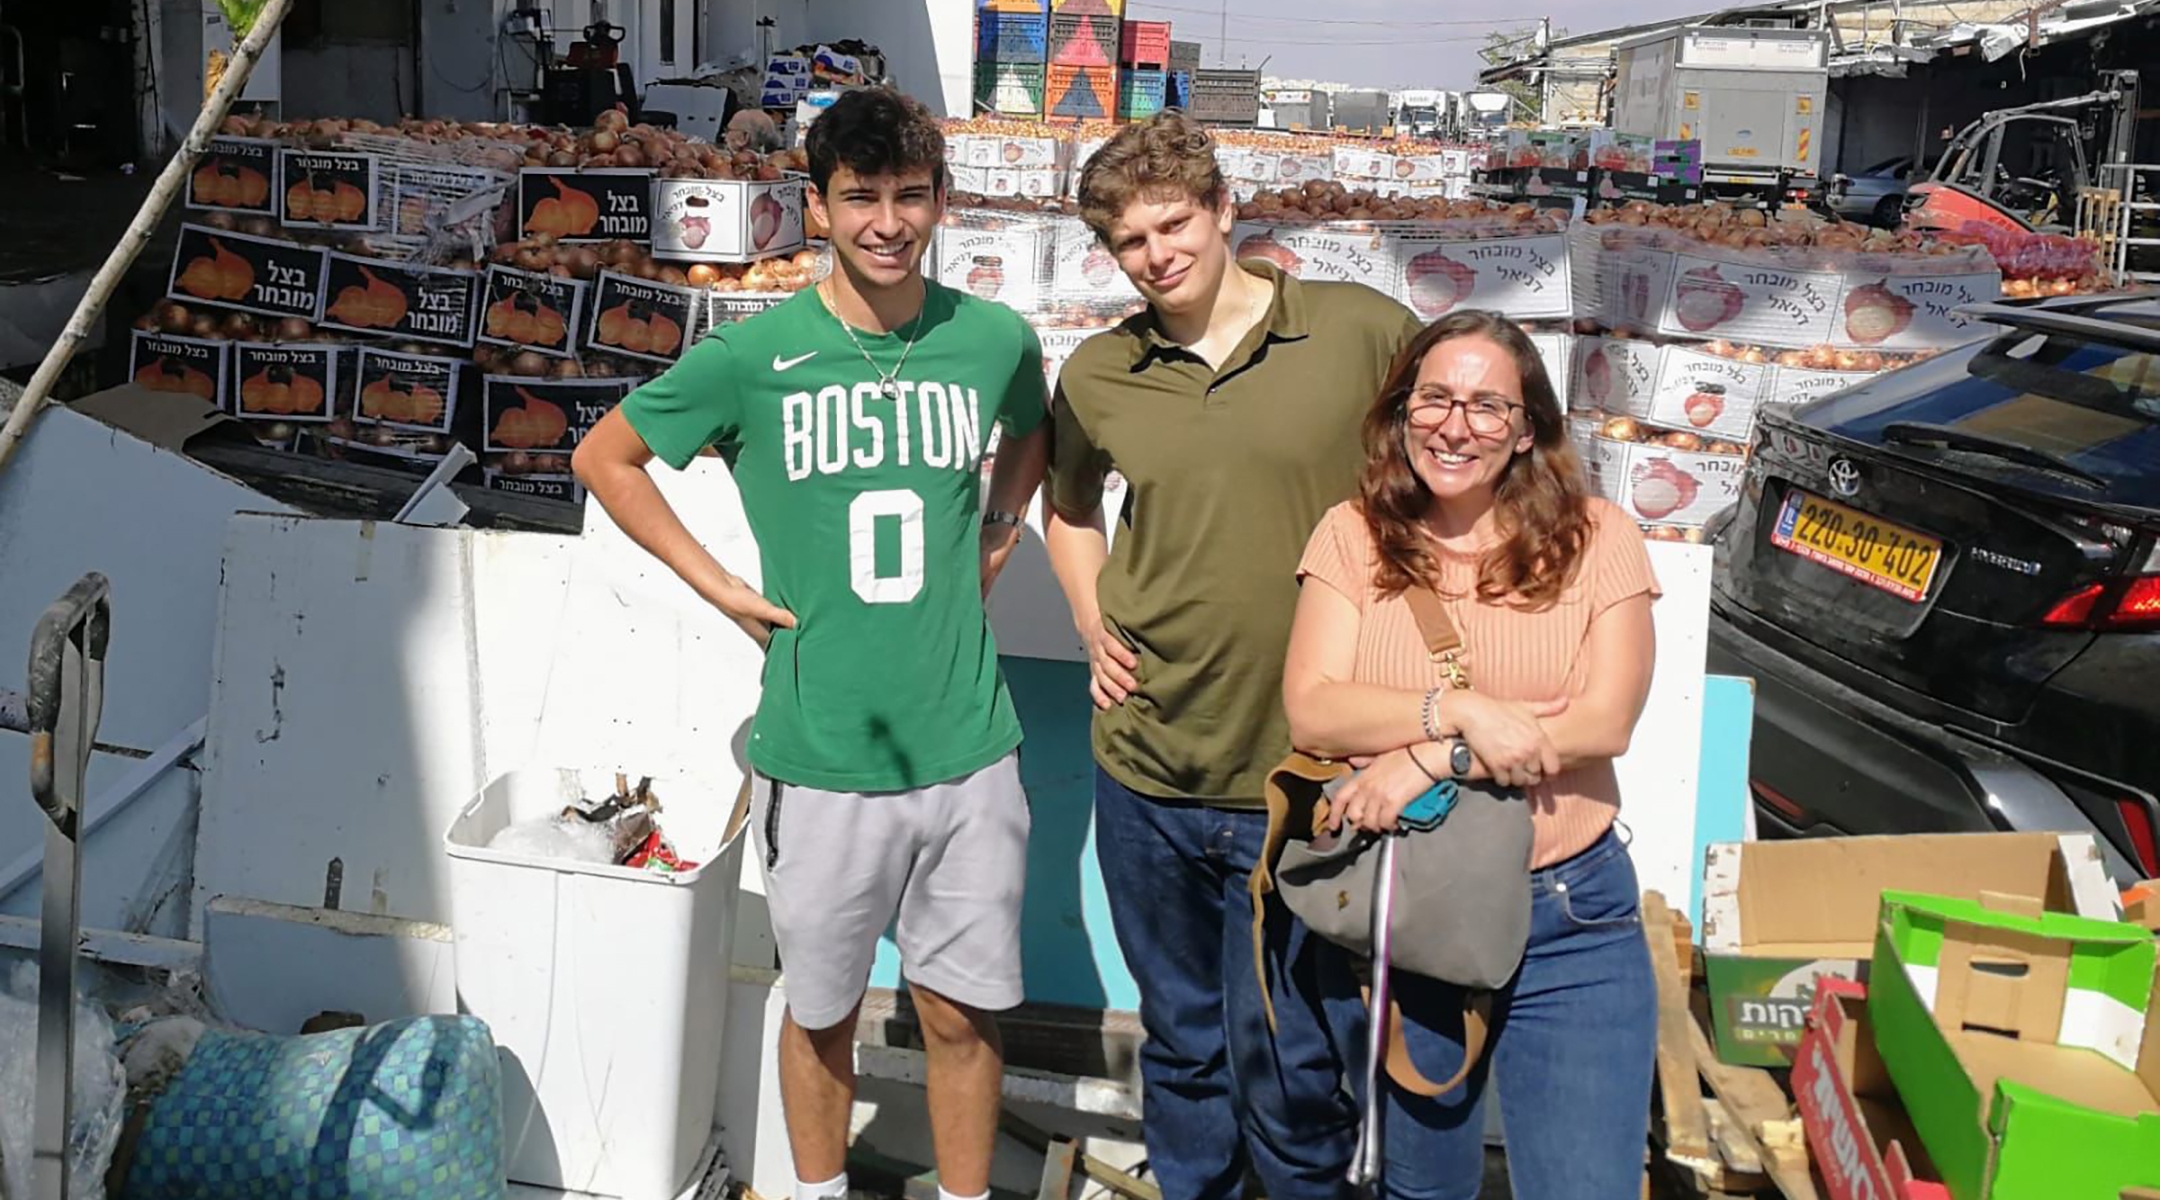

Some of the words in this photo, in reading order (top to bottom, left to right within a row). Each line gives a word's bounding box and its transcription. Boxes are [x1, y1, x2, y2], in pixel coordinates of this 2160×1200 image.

[239, 144, 264, 157] בצל
[294, 157, 332, 170] מובחר
[335, 158, 360, 170] בצל
[608, 190, 639, 213] בצל
[705, 186, 726, 203] בצל
[599, 215, 648, 234] מובחר
[959, 236, 994, 249] מובחר
[1286, 236, 1341, 252] מובחר
[1346, 245, 1373, 274] בצל
[1468, 245, 1522, 261] מובחר
[1529, 248, 1556, 277] בצל
[268, 260, 305, 287] בצל
[1497, 266, 1543, 293] דניאל
[1744, 272, 1798, 290] מובחר
[501, 274, 529, 290] בחר
[539, 281, 564, 297] בצל
[1901, 281, 1952, 295] מובחר
[254, 283, 315, 310] מובחר
[418, 287, 450, 311] בצל
[614, 283, 652, 300] מובחר
[656, 290, 680, 306] בצל
[1803, 283, 1826, 313] בצל
[1957, 285, 1975, 304] צל
[1767, 294, 1809, 326] דניאל
[1925, 301, 1967, 328] דאל
[407, 311, 458, 333] מובחר
[145, 340, 182, 355] מובחר
[184, 345, 209, 358] בצל
[249, 351, 288, 363] מובחר
[291, 351, 316, 363] בצל
[375, 357, 412, 372] מובחר
[416, 360, 441, 375] בצל
[1684, 363, 1723, 374] מובחר
[1727, 366, 1746, 385] בצל
[1794, 377, 1835, 389] מובחר
[782, 381, 981, 482] BOSTON
[499, 479, 535, 492] מובחר
[538, 481, 563, 494] בצל
[850, 489, 925, 603] 0
